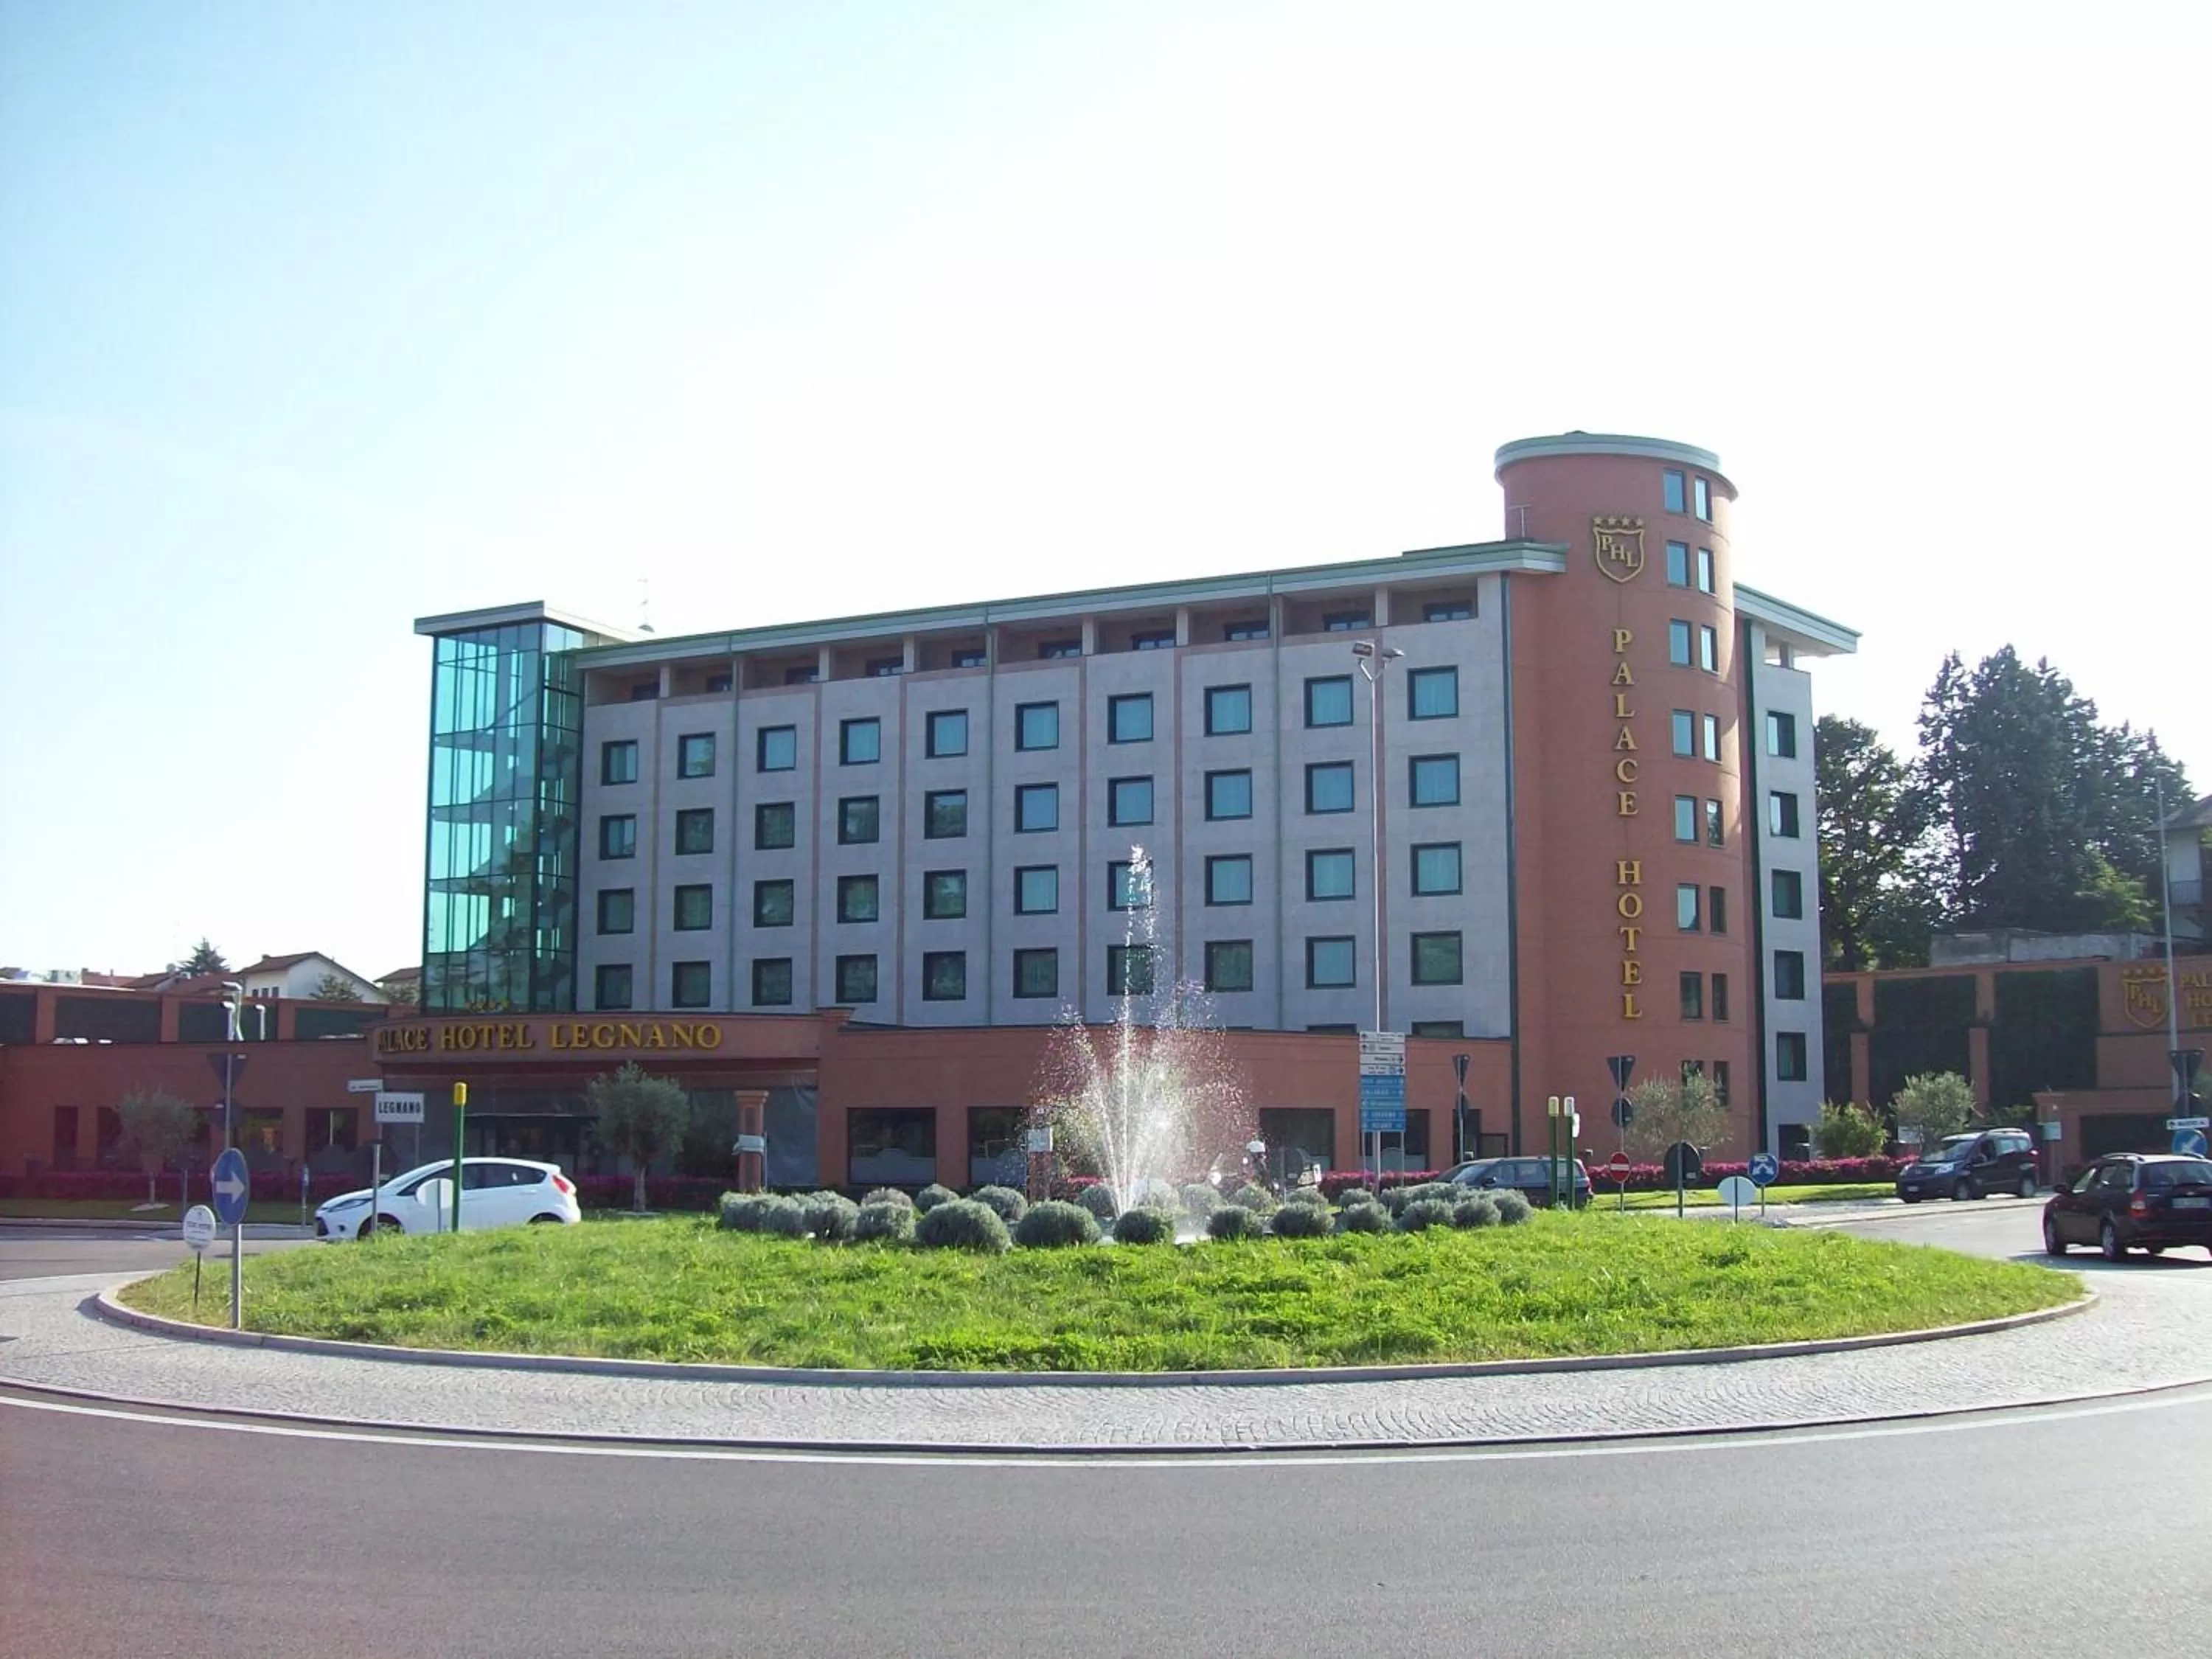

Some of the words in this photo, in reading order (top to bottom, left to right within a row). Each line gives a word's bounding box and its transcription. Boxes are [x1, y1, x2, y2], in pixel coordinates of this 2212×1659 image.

[1601, 535, 1638, 567] PHL
[1613, 628, 1639, 815] PALACE
[1617, 860, 1643, 1018] HOTEL
[441, 1023, 535, 1051] HOTEL
[549, 1024, 723, 1049] LEGNANO
[378, 1101, 421, 1114] LEGNANO
